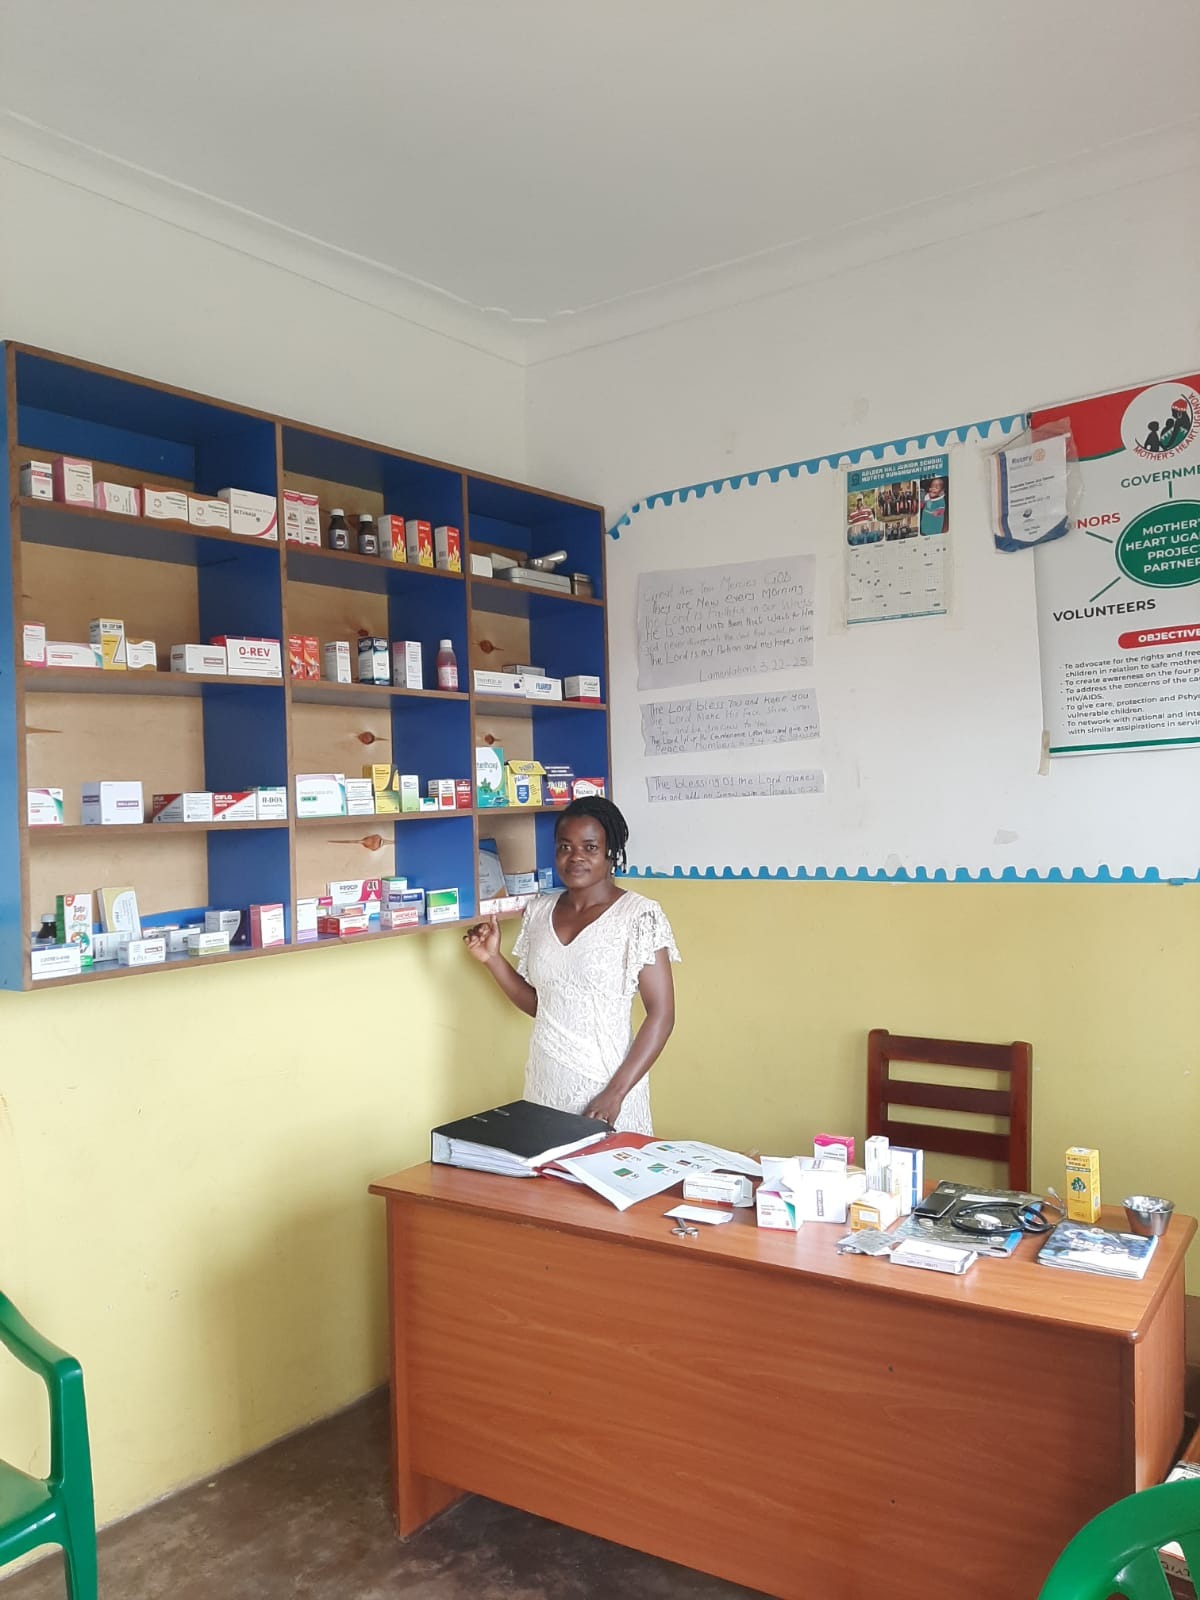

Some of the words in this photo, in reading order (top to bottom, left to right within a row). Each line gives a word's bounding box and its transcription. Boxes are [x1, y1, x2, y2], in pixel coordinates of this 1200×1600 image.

[1133, 446, 1175, 461] MOTHER'S
[1176, 428, 1198, 454] HEART
[1077, 512, 1121, 528] NORS
[1126, 536, 1167, 551] HEART
[676, 601, 692, 611] are
[1053, 598, 1157, 622] VOLUNTEERS
[238, 646, 271, 657] O-REV
[1075, 660, 1111, 669] advocate
[1113, 657, 1124, 665] for
[1140, 653, 1164, 662] rights
[1166, 650, 1183, 659] and
[1065, 669, 1098, 679] children
[1100, 667, 1107, 675] in
[1109, 664, 1139, 673] relation
[1151, 661, 1168, 669] safe
[1076, 677, 1101, 685] create
[1102, 673, 1144, 682] awareness
[1158, 669, 1172, 677] the
[1175, 667, 1191, 675] four
[1076, 685, 1107, 693] address
[1109, 683, 1122, 691] the
[1124, 680, 1160, 689] concerns
[1162, 677, 1171, 685] of
[1172, 676, 1187, 684] the
[744, 696, 759, 706] and
[1077, 702, 1093, 711] give
[1117, 697, 1157, 707] protection
[1160, 694, 1175, 702] and
[1067, 709, 1109, 719] vulnerable
[1078, 718, 1111, 726] network
[1113, 715, 1131, 724] with
[1132, 712, 1164, 721] national
[1167, 711, 1183, 719] and
[1088, 726, 1114, 734] similar
